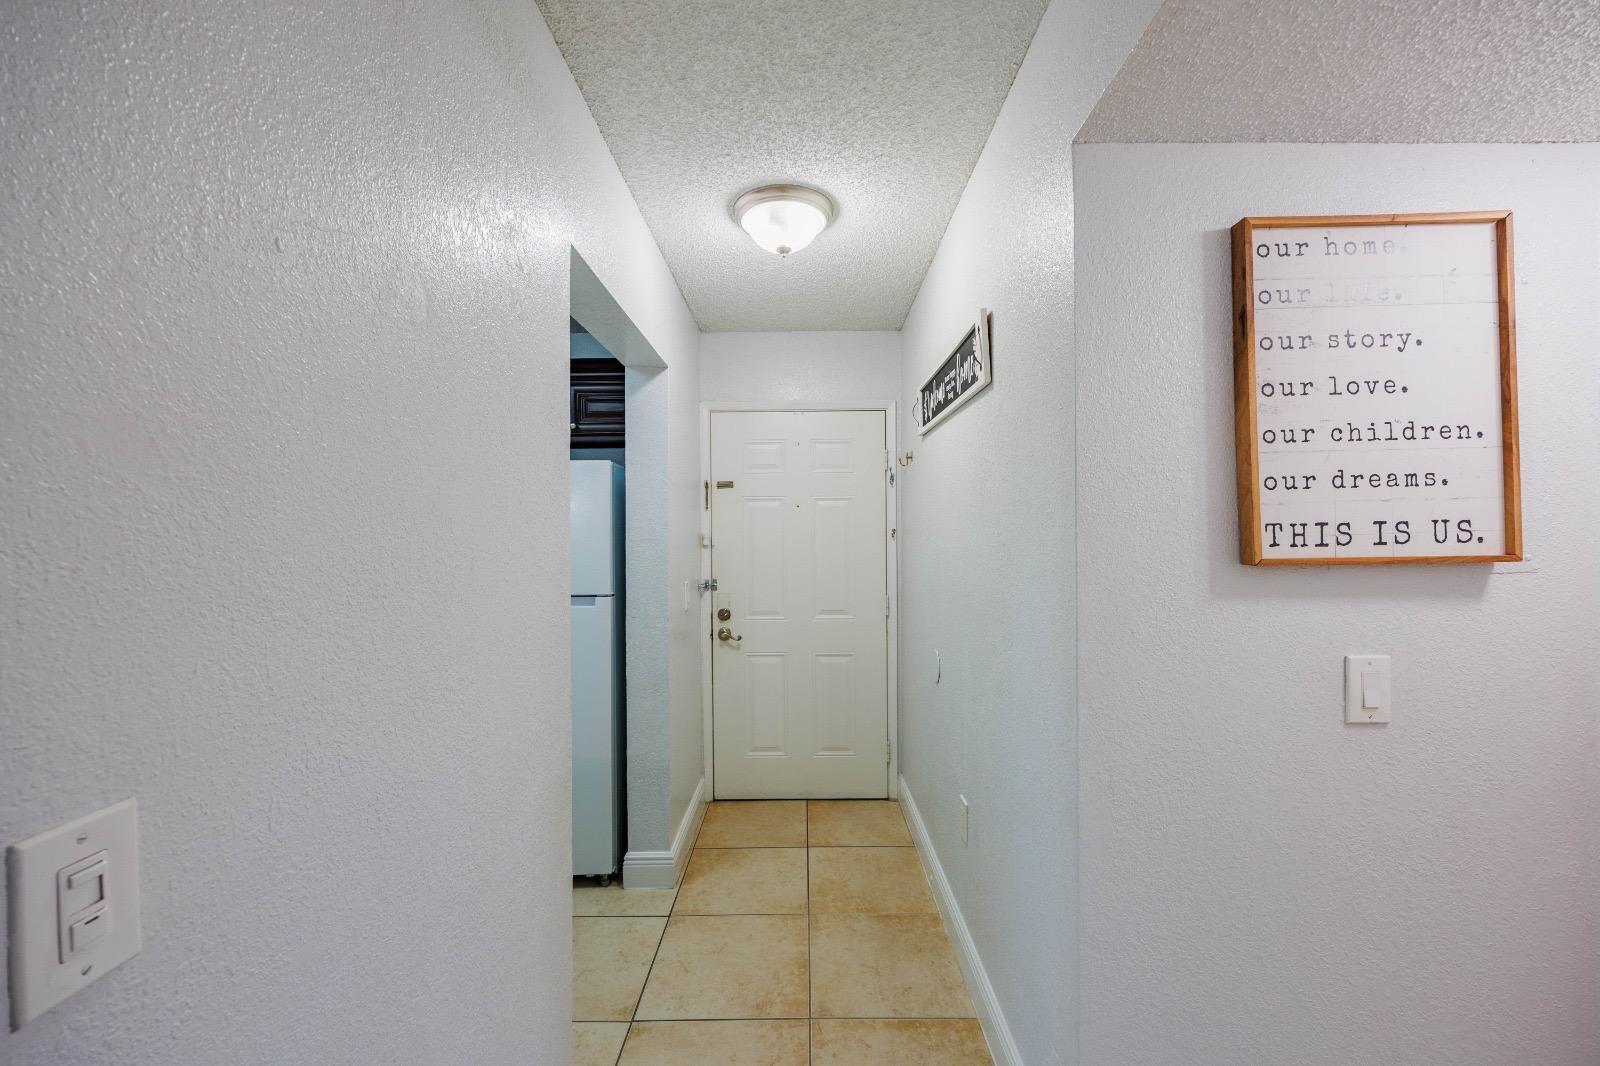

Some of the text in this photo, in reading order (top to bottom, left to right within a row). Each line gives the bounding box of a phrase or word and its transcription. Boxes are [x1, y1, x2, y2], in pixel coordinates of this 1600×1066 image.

[1257, 242, 1309, 258] our
[1258, 289, 1310, 304] our
[1260, 329, 1422, 352] our story.
[1261, 376, 1408, 397] our love.
[1263, 419, 1483, 444] our children.
[1264, 469, 1448, 490] our dreams.
[1265, 519, 1484, 547] THIS IS US.
